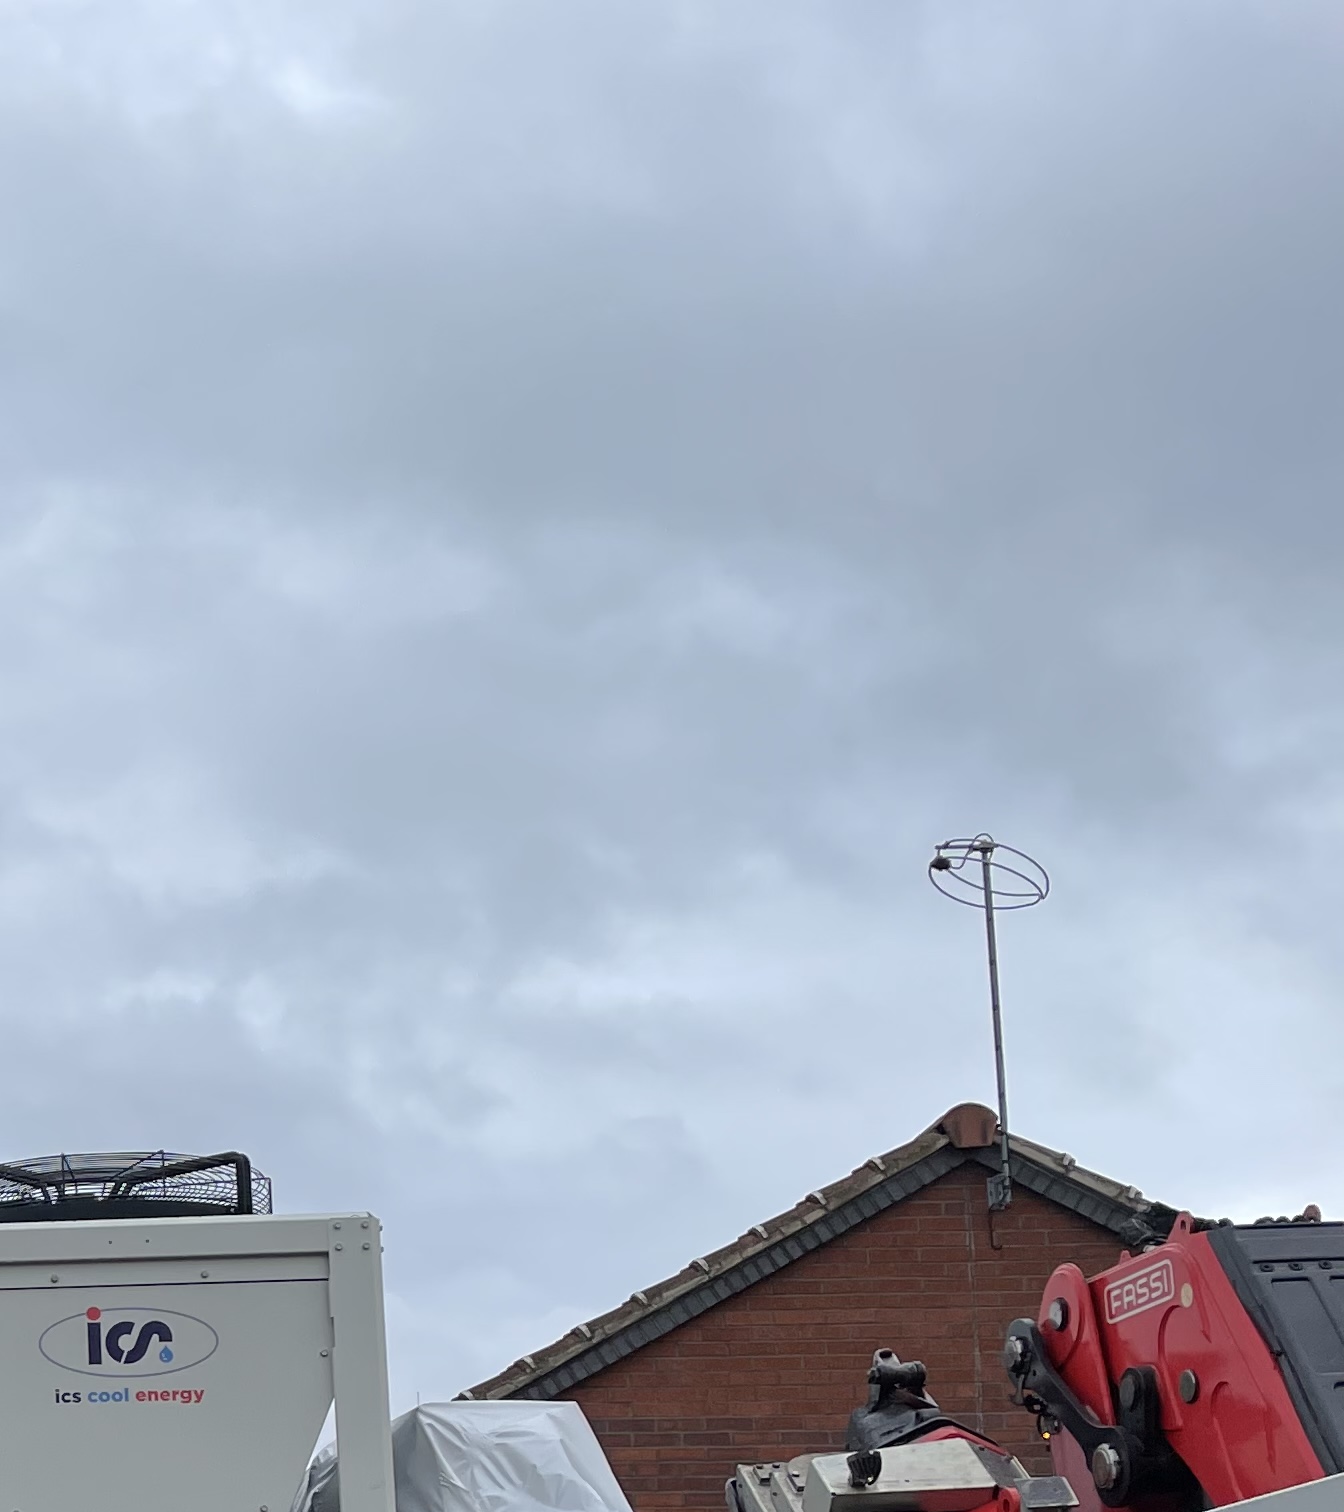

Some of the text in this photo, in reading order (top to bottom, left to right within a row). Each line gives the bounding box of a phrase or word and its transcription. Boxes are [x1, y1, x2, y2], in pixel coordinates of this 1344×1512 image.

[1110, 1268, 1168, 1315] FASSI
[55, 1387, 205, 1404] ics cool energy
